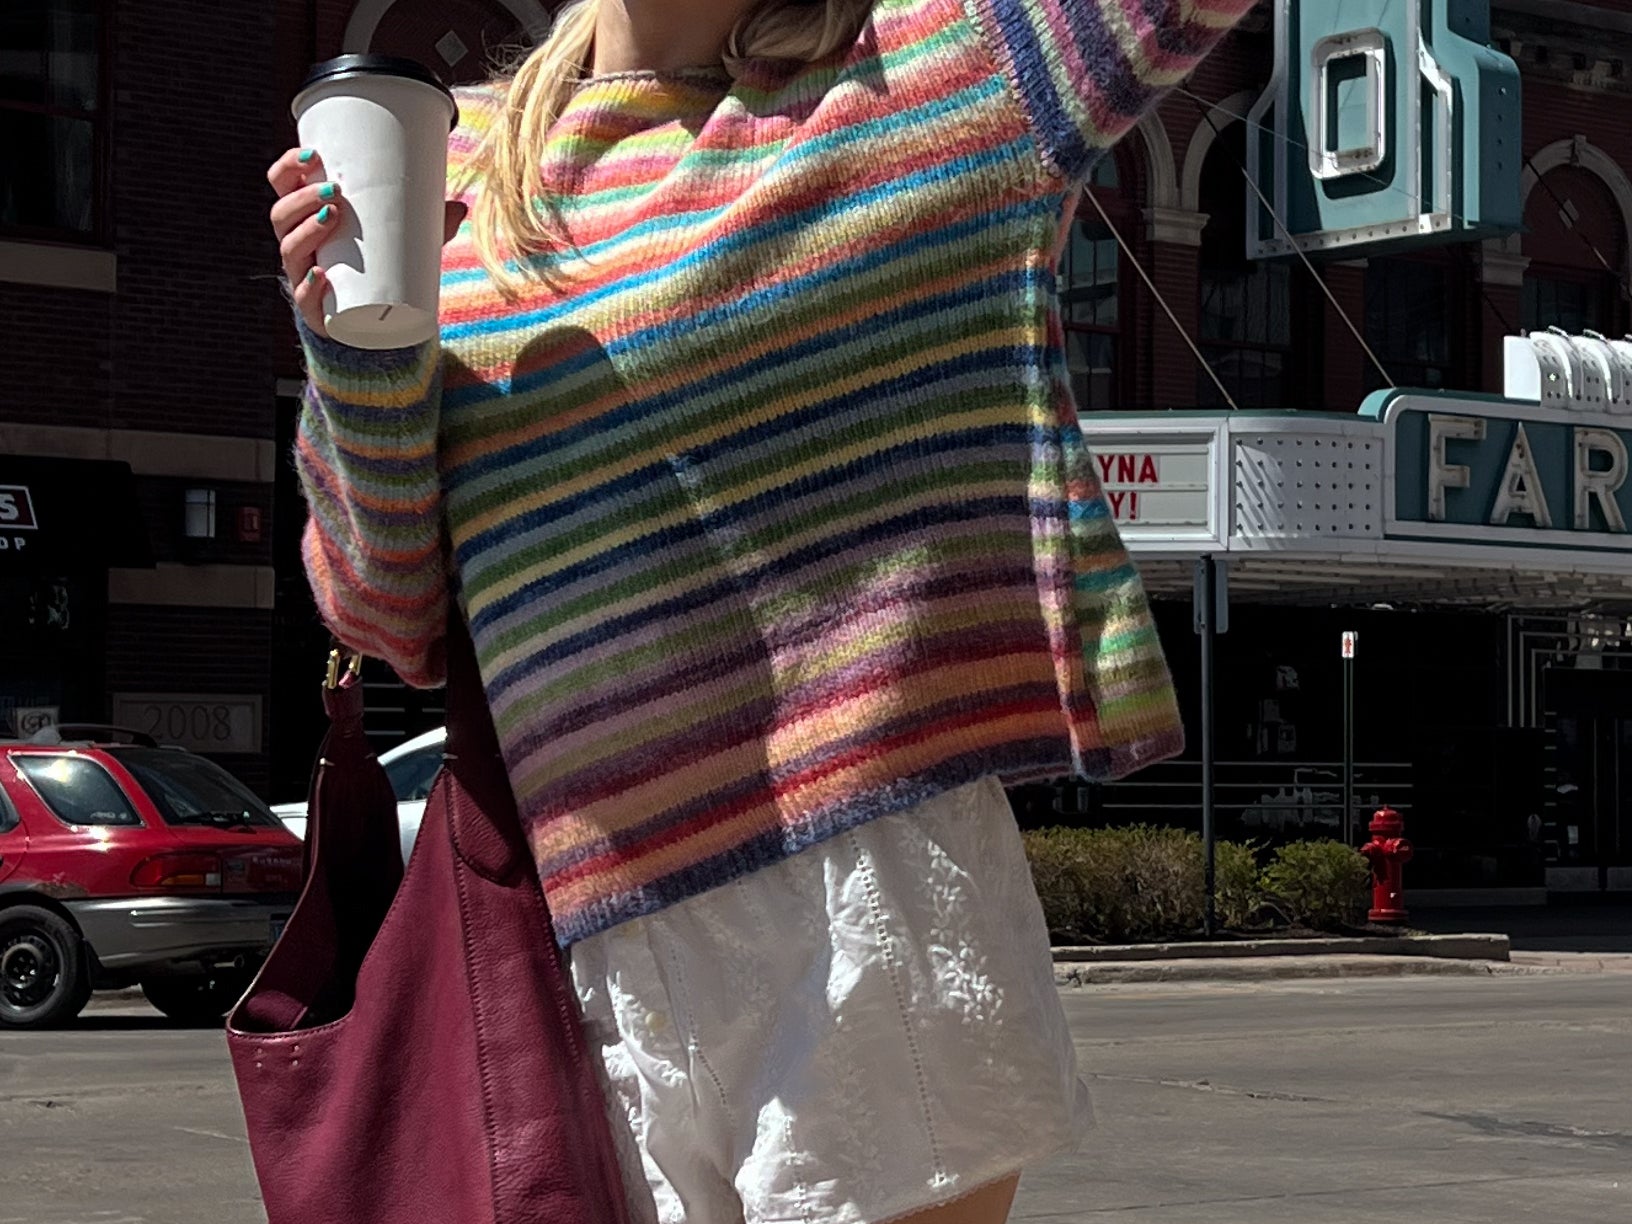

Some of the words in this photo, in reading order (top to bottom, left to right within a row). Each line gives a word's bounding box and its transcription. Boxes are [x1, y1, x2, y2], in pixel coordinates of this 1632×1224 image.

[1310, 29, 1386, 179] O
[1097, 453, 1158, 483] YNA
[1428, 413, 1629, 531] FAR
[1108, 490, 1136, 520] Y!
[144, 705, 232, 740] 2008
